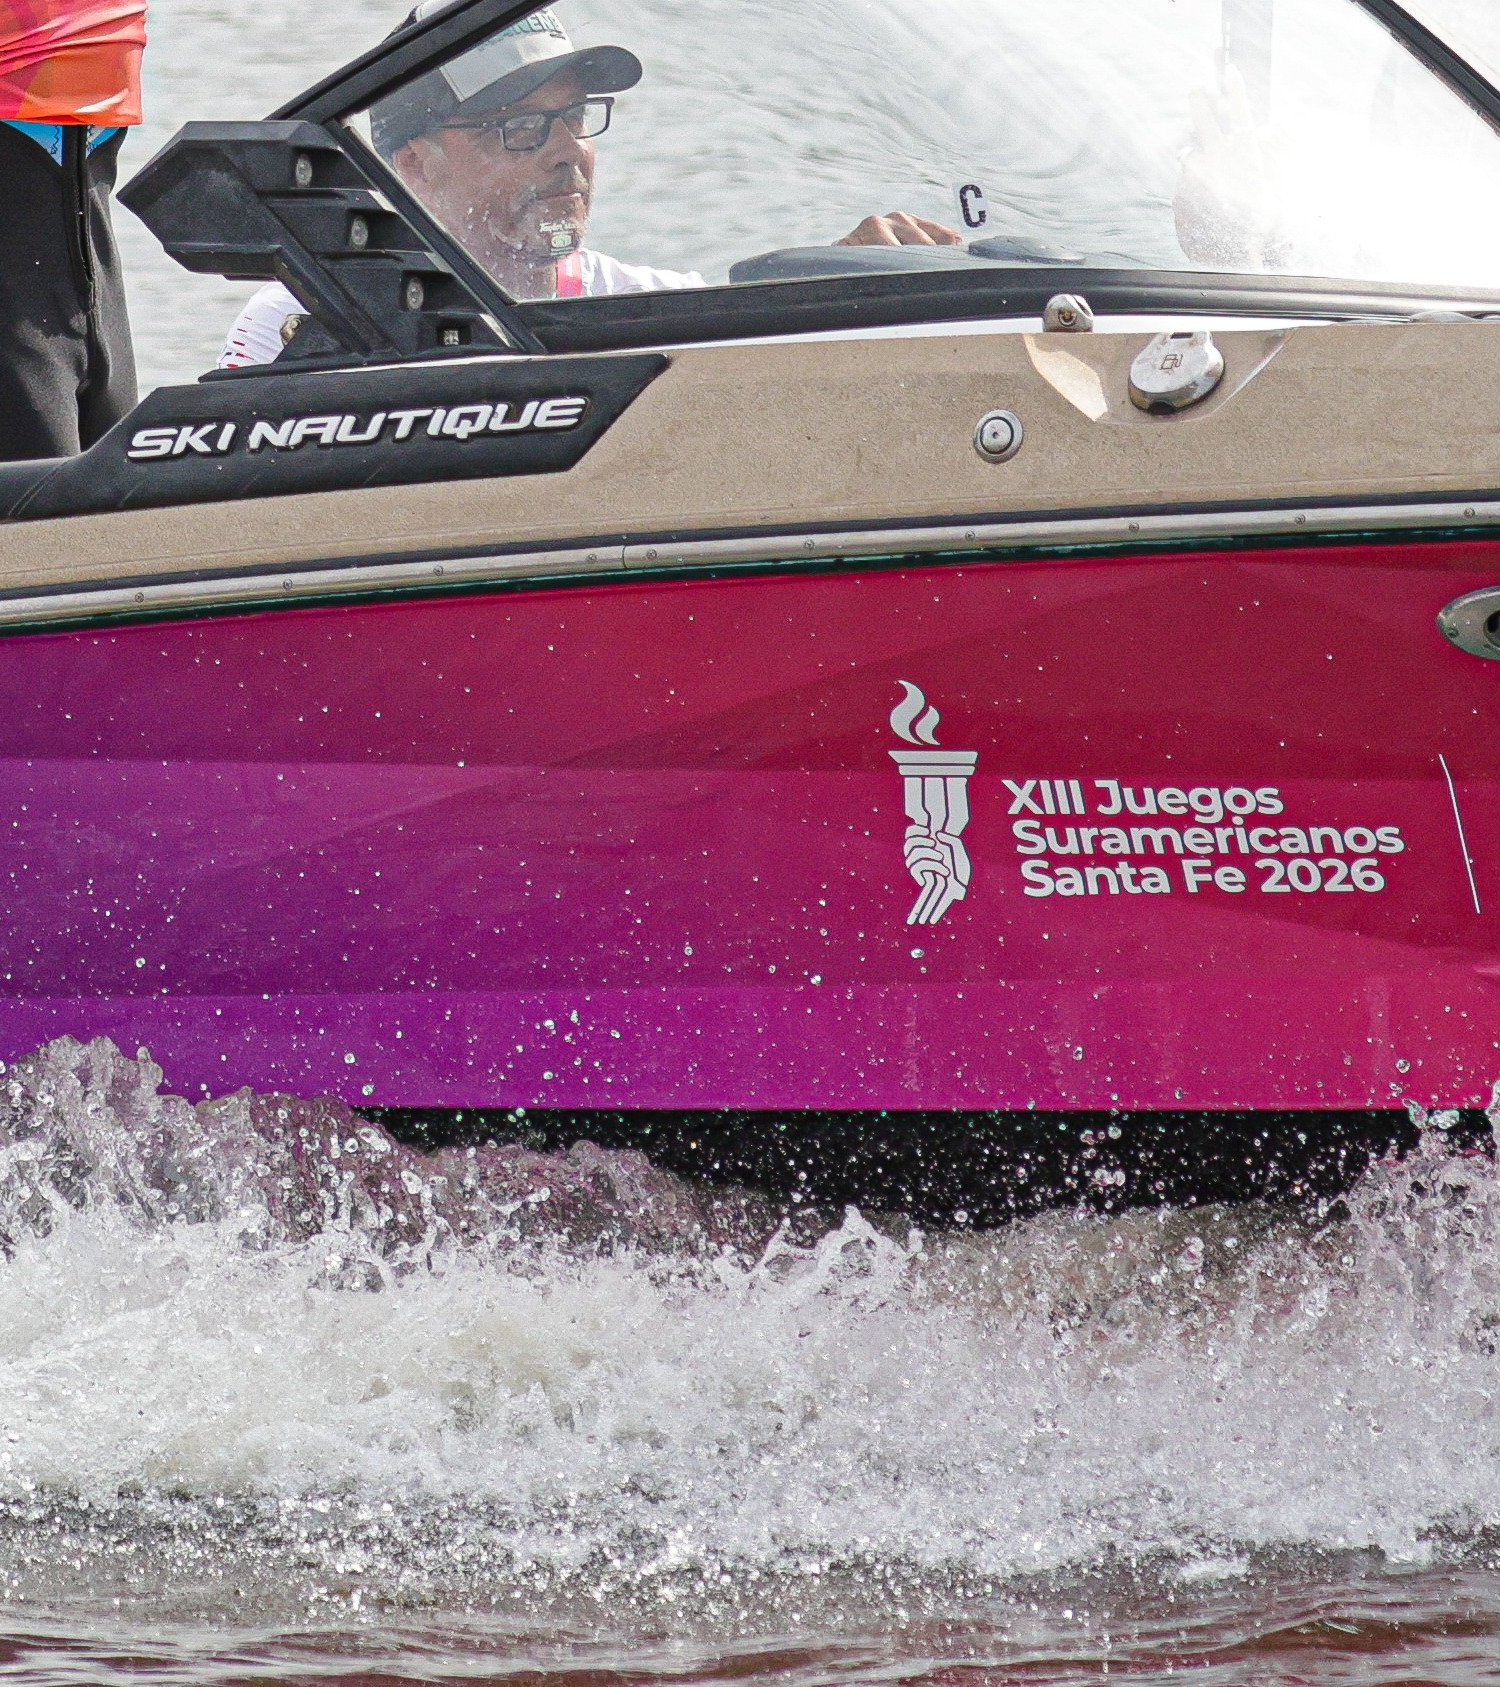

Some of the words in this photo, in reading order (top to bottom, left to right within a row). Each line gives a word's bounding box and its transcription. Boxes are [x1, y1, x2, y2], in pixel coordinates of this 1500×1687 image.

[959, 183, 987, 229] C
[126, 421, 237, 459] SKI
[248, 396, 587, 453] NAUTIQUE
[1001, 779, 1087, 815] XIII
[1093, 779, 1286, 824] Juegos
[1010, 815, 1405, 856] Suramericanos
[1020, 859, 1172, 899] Santa
[1181, 858, 1247, 894] Fe
[1253, 857, 1387, 894] 2026
